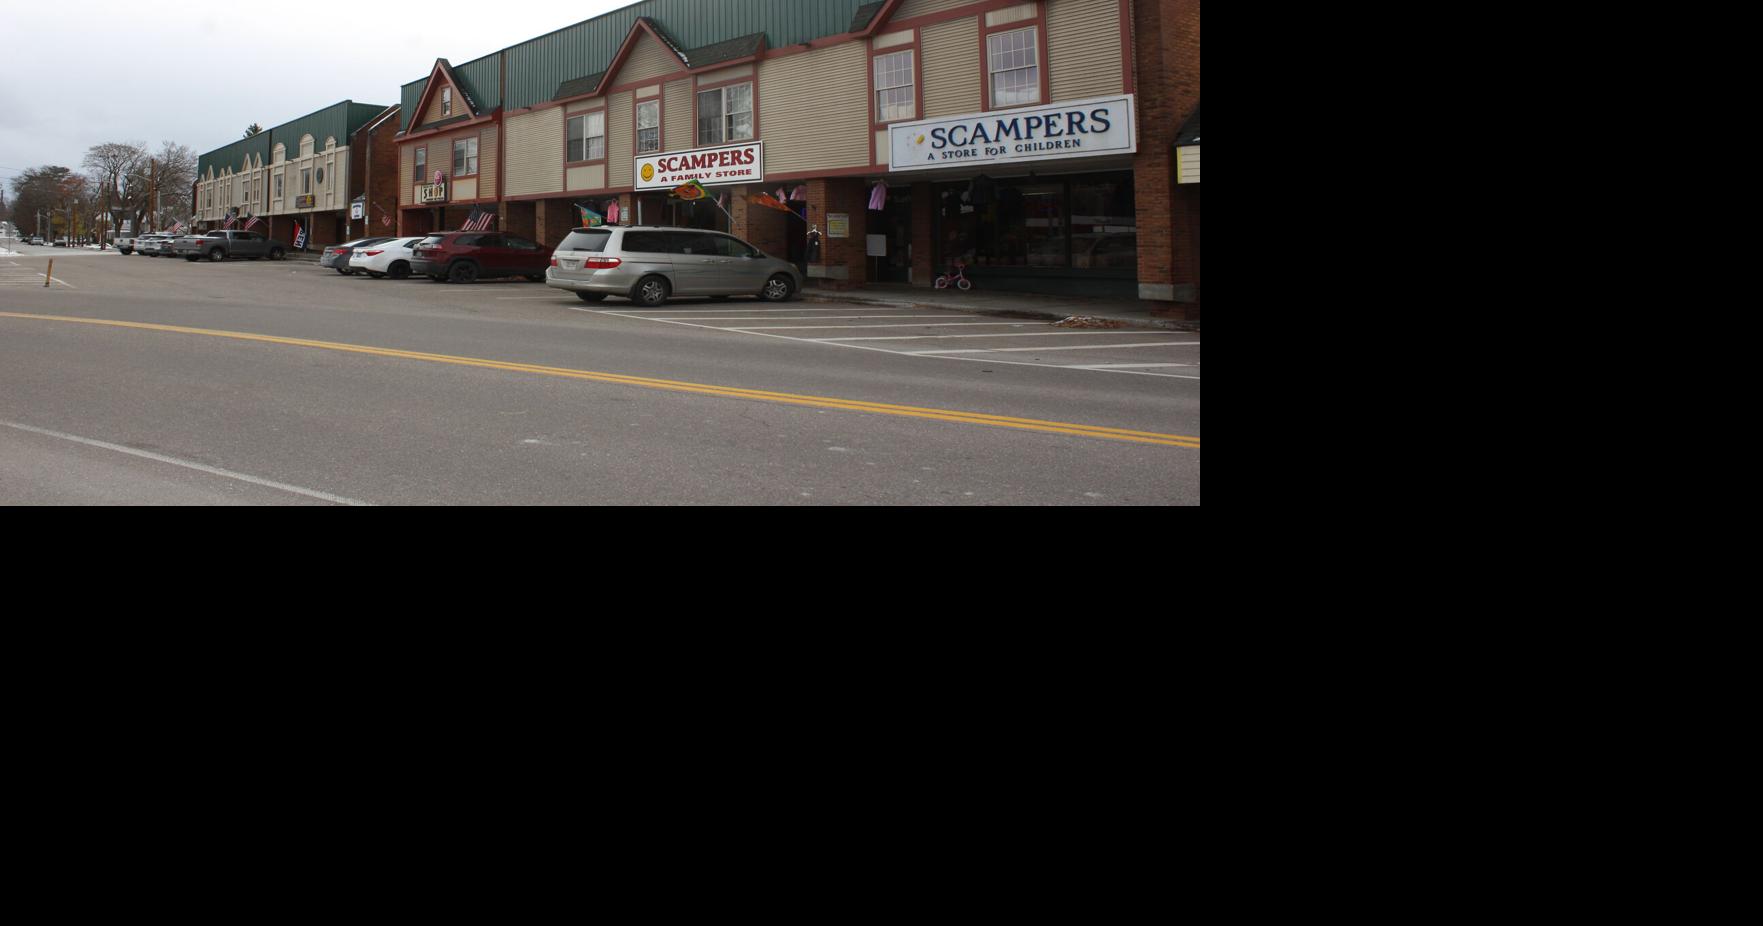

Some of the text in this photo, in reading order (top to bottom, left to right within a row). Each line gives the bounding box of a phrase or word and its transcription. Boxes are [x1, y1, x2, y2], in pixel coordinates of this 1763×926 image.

[931, 109, 1111, 149] SCAMPERS
[927, 139, 1081, 160] A STORE FOR CHILDREN
[658, 148, 754, 173] SCAMPERS
[671, 172, 711, 181] FAMILY
[715, 169, 752, 177] STORE
[424, 187, 443, 199] SHOP
